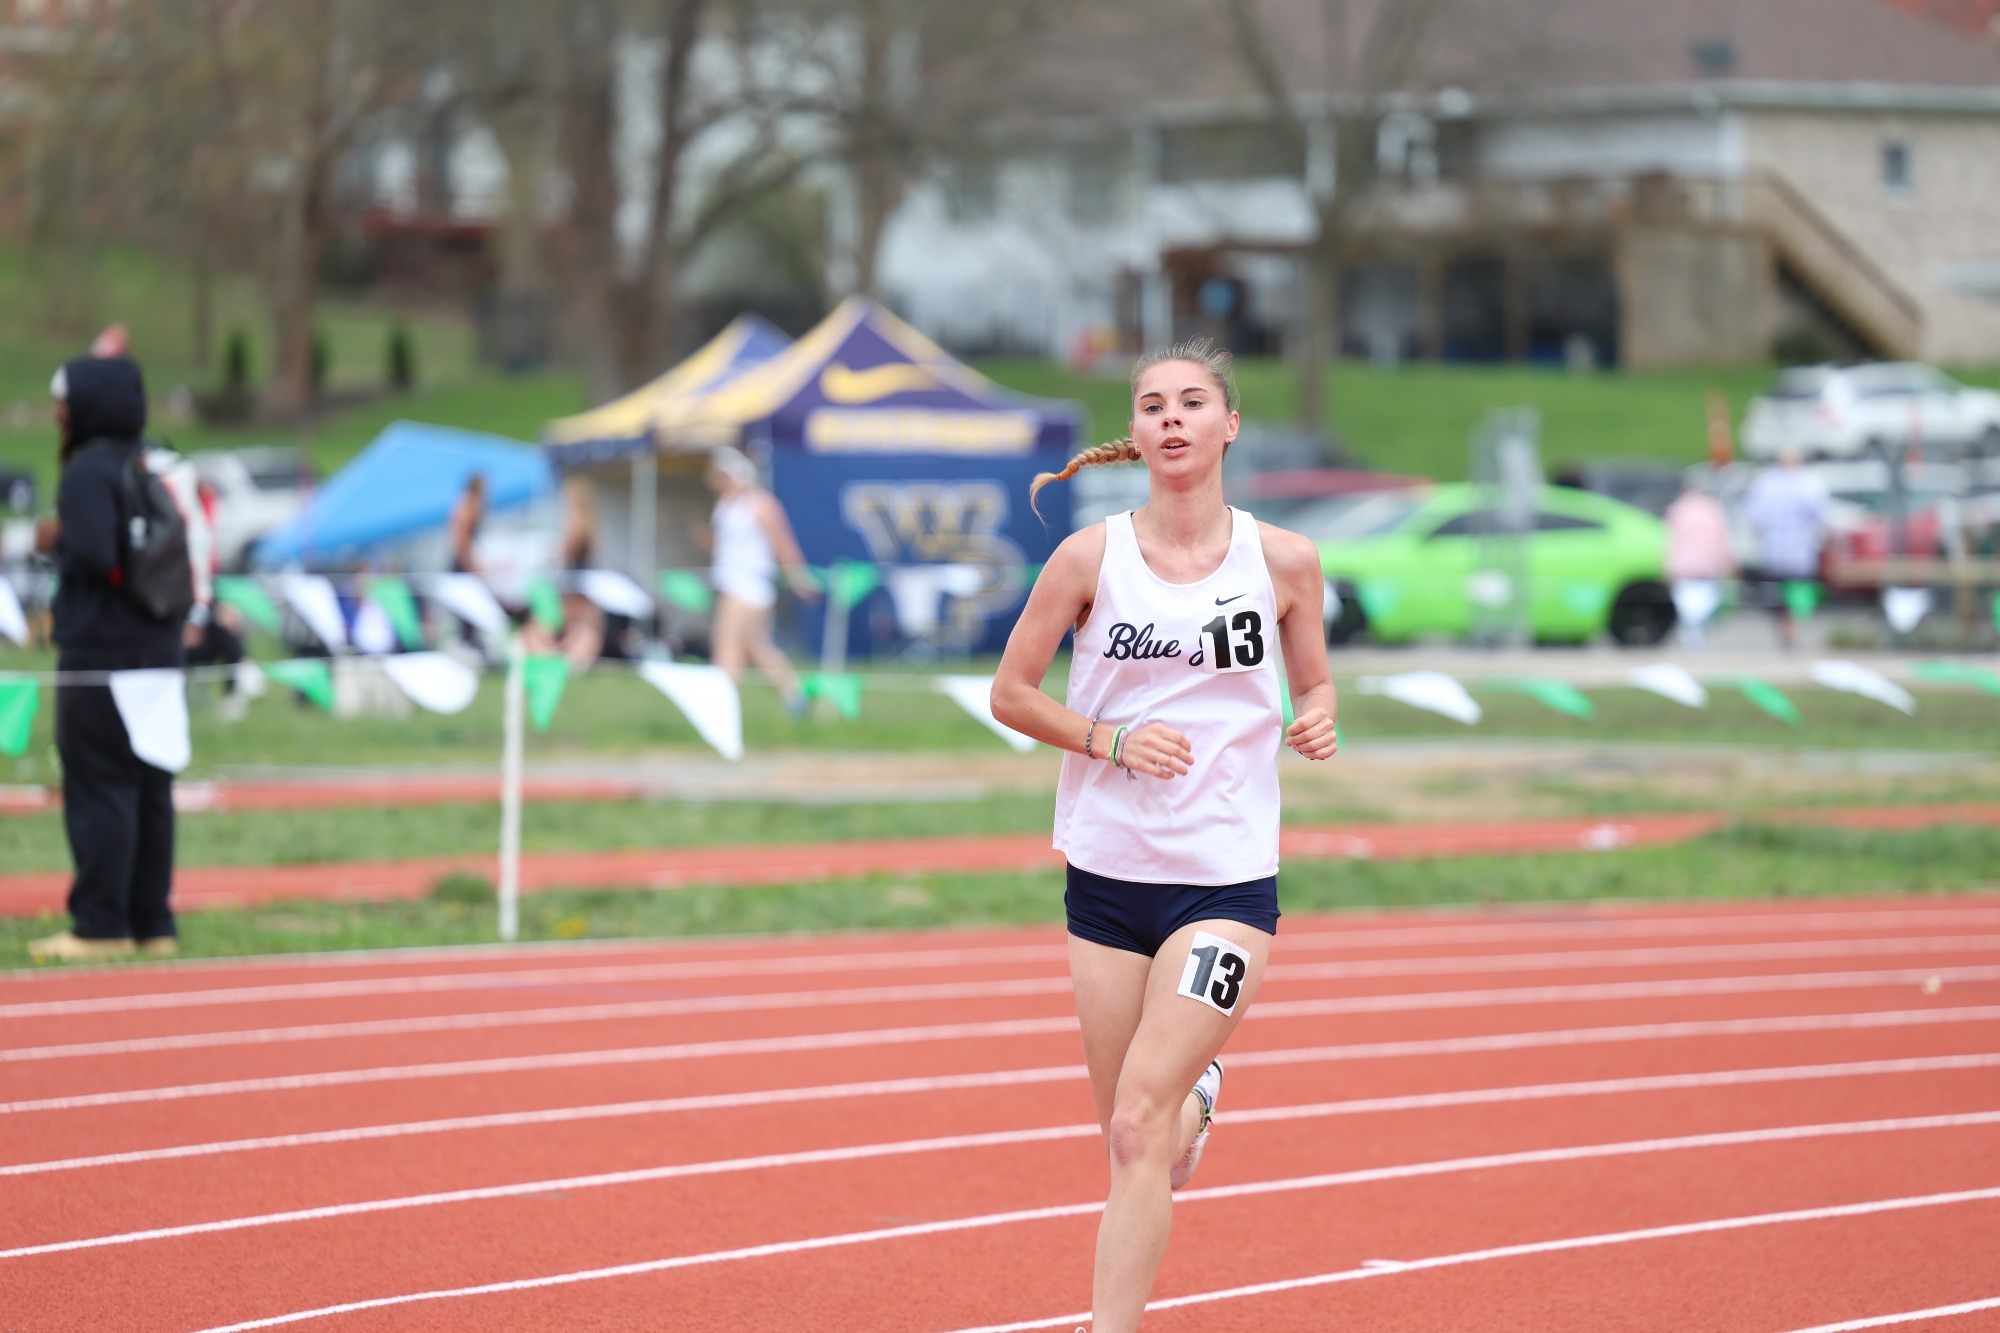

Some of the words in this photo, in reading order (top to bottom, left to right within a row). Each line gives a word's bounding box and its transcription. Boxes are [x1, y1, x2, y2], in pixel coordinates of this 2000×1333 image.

[1104, 622, 1182, 660] Blue
[1201, 610, 1265, 670] 13
[1190, 944, 1246, 1010] 13
